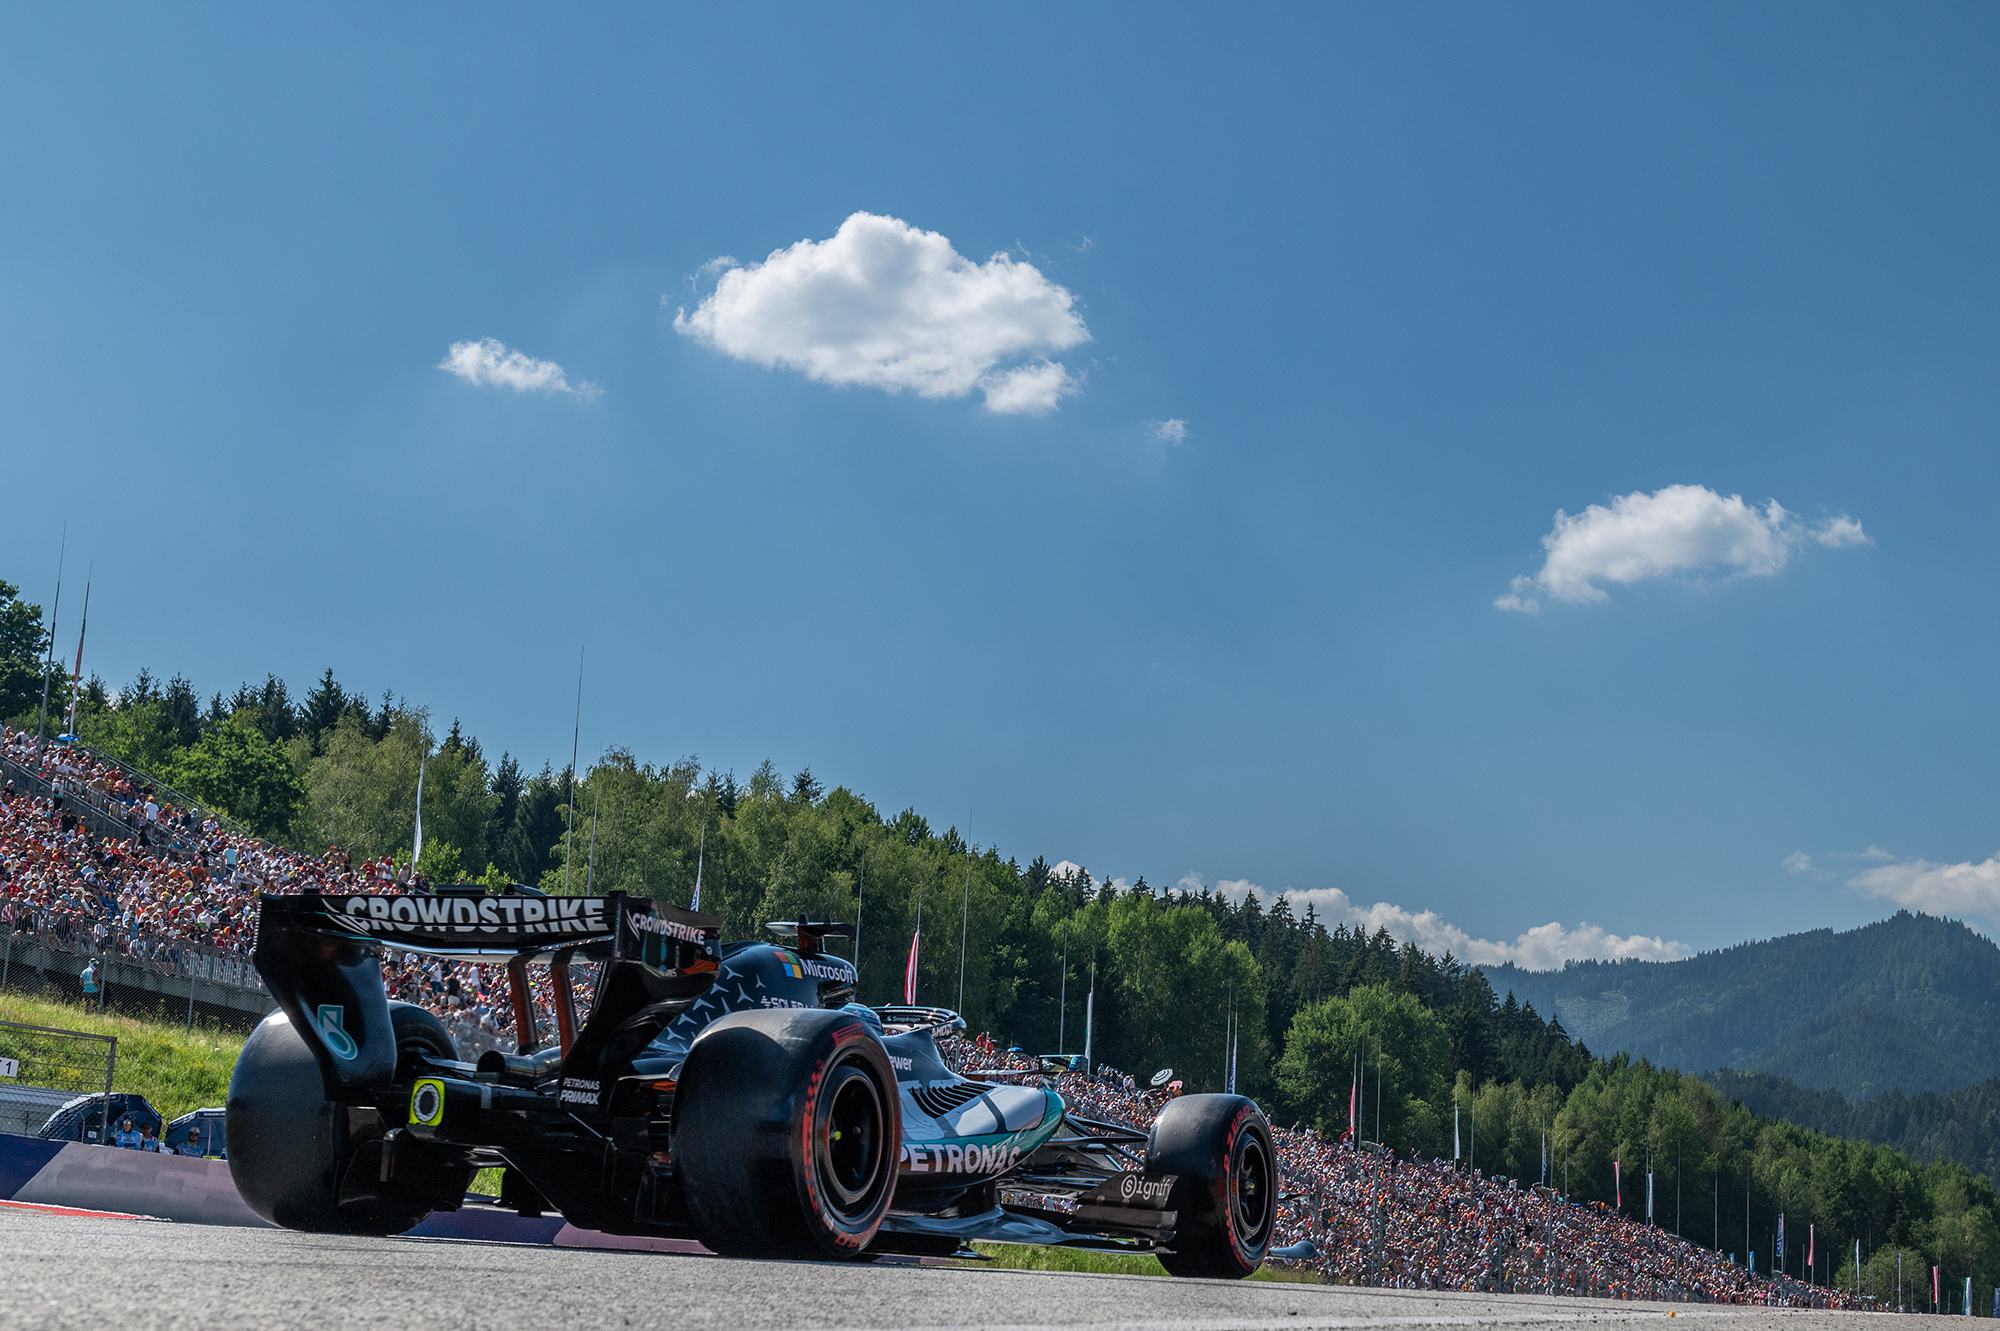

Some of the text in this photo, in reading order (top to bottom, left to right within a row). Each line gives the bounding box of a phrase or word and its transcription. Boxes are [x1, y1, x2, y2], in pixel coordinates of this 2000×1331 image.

[346, 897, 608, 932] CROWDSTRIKE
[632, 912, 705, 945] CROWDSTRIKE
[800, 958, 854, 984] Microsoft
[563, 1077, 600, 1090] PETRONAS
[560, 1090, 602, 1105] PRIMAX
